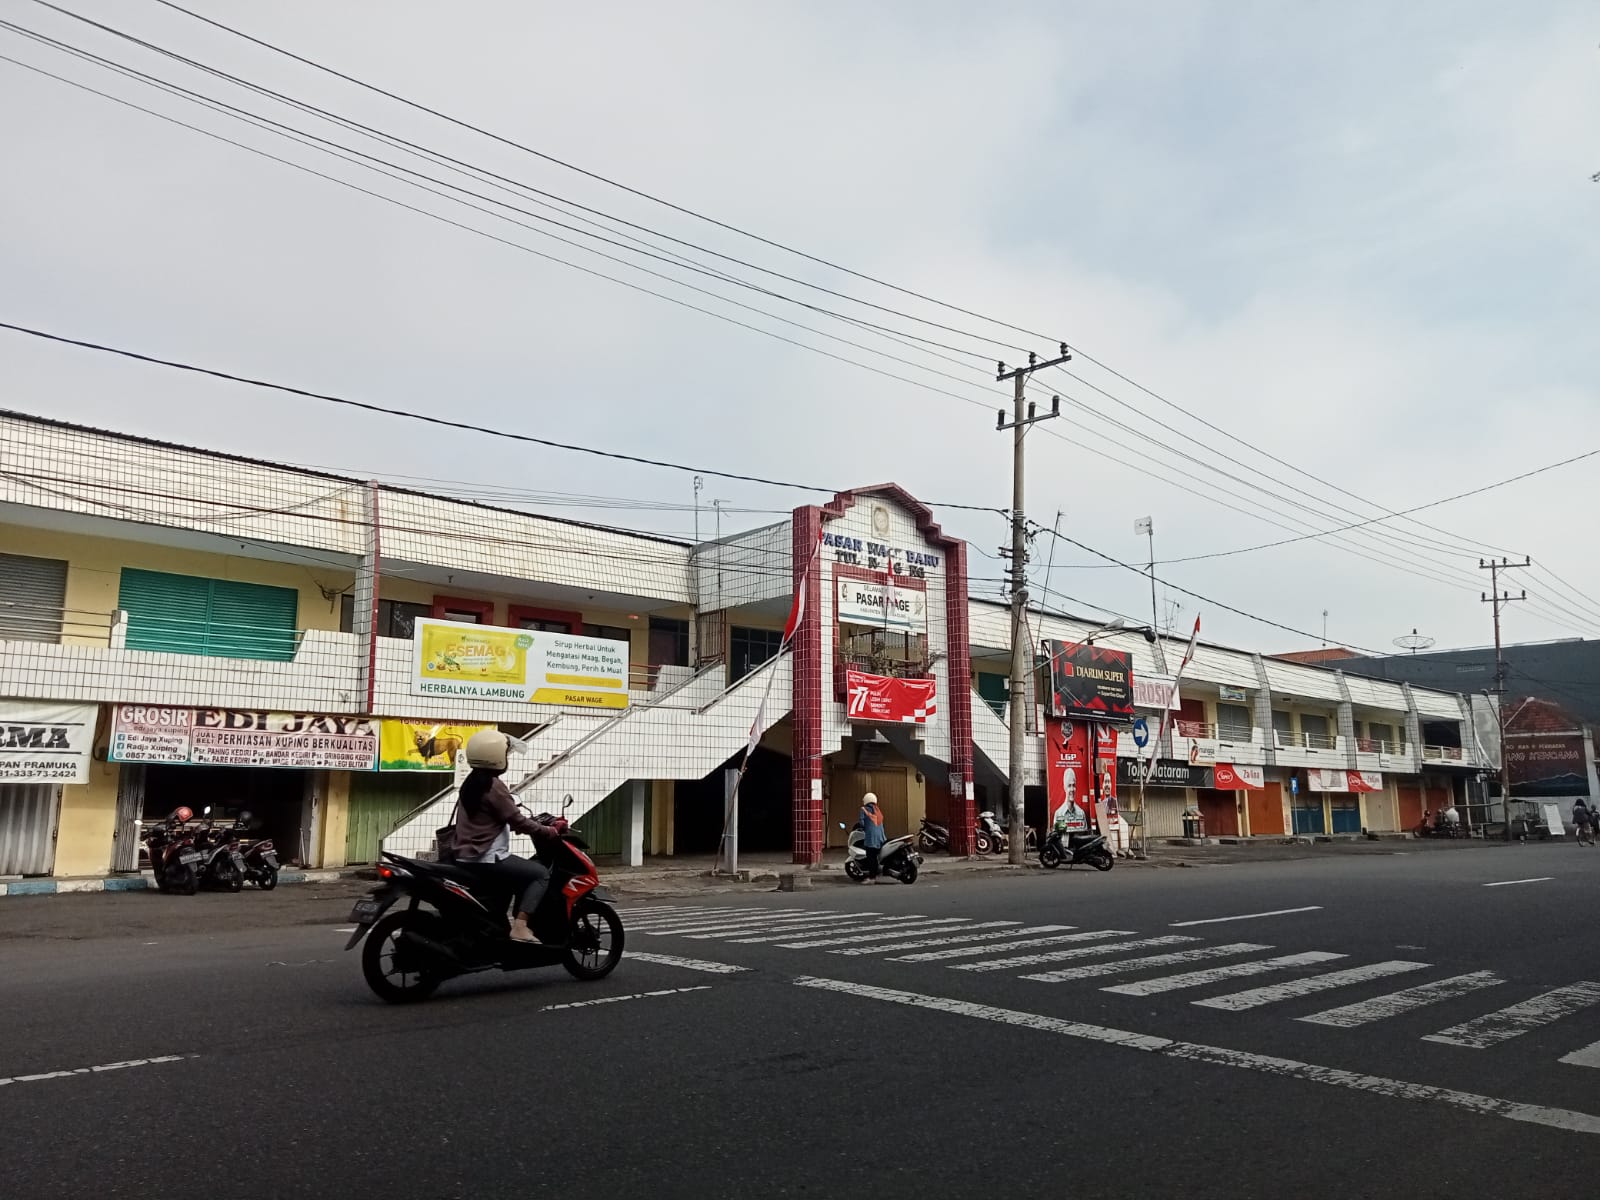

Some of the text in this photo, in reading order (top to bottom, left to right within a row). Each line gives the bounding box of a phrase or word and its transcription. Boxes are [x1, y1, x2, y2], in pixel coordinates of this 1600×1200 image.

[906, 550, 939, 567] BARU
[856, 592, 884, 608] PASAR
[554, 640, 615, 653] Sirup Herbal Untuk
[546, 650, 580, 660] Mengatasi
[546, 661, 580, 671] Kembung,
[582, 664, 599, 672] Perih
[607, 666, 622, 674] Mual
[1076, 666, 1125, 683] DJARUM SUPER
[420, 683, 525, 699] HERBALNYA LAMBUNG
[120, 705, 376, 736] GROSIR EDI JAYA
[140, 735, 157, 743] Jaya
[217, 734, 373, 751] PERHIASAN XUPING BERKUALITAS
[291, 751, 311, 759] KEDIRI
[24, 761, 77, 769] PRAMUKA
[1126, 762, 1148, 777] Too
